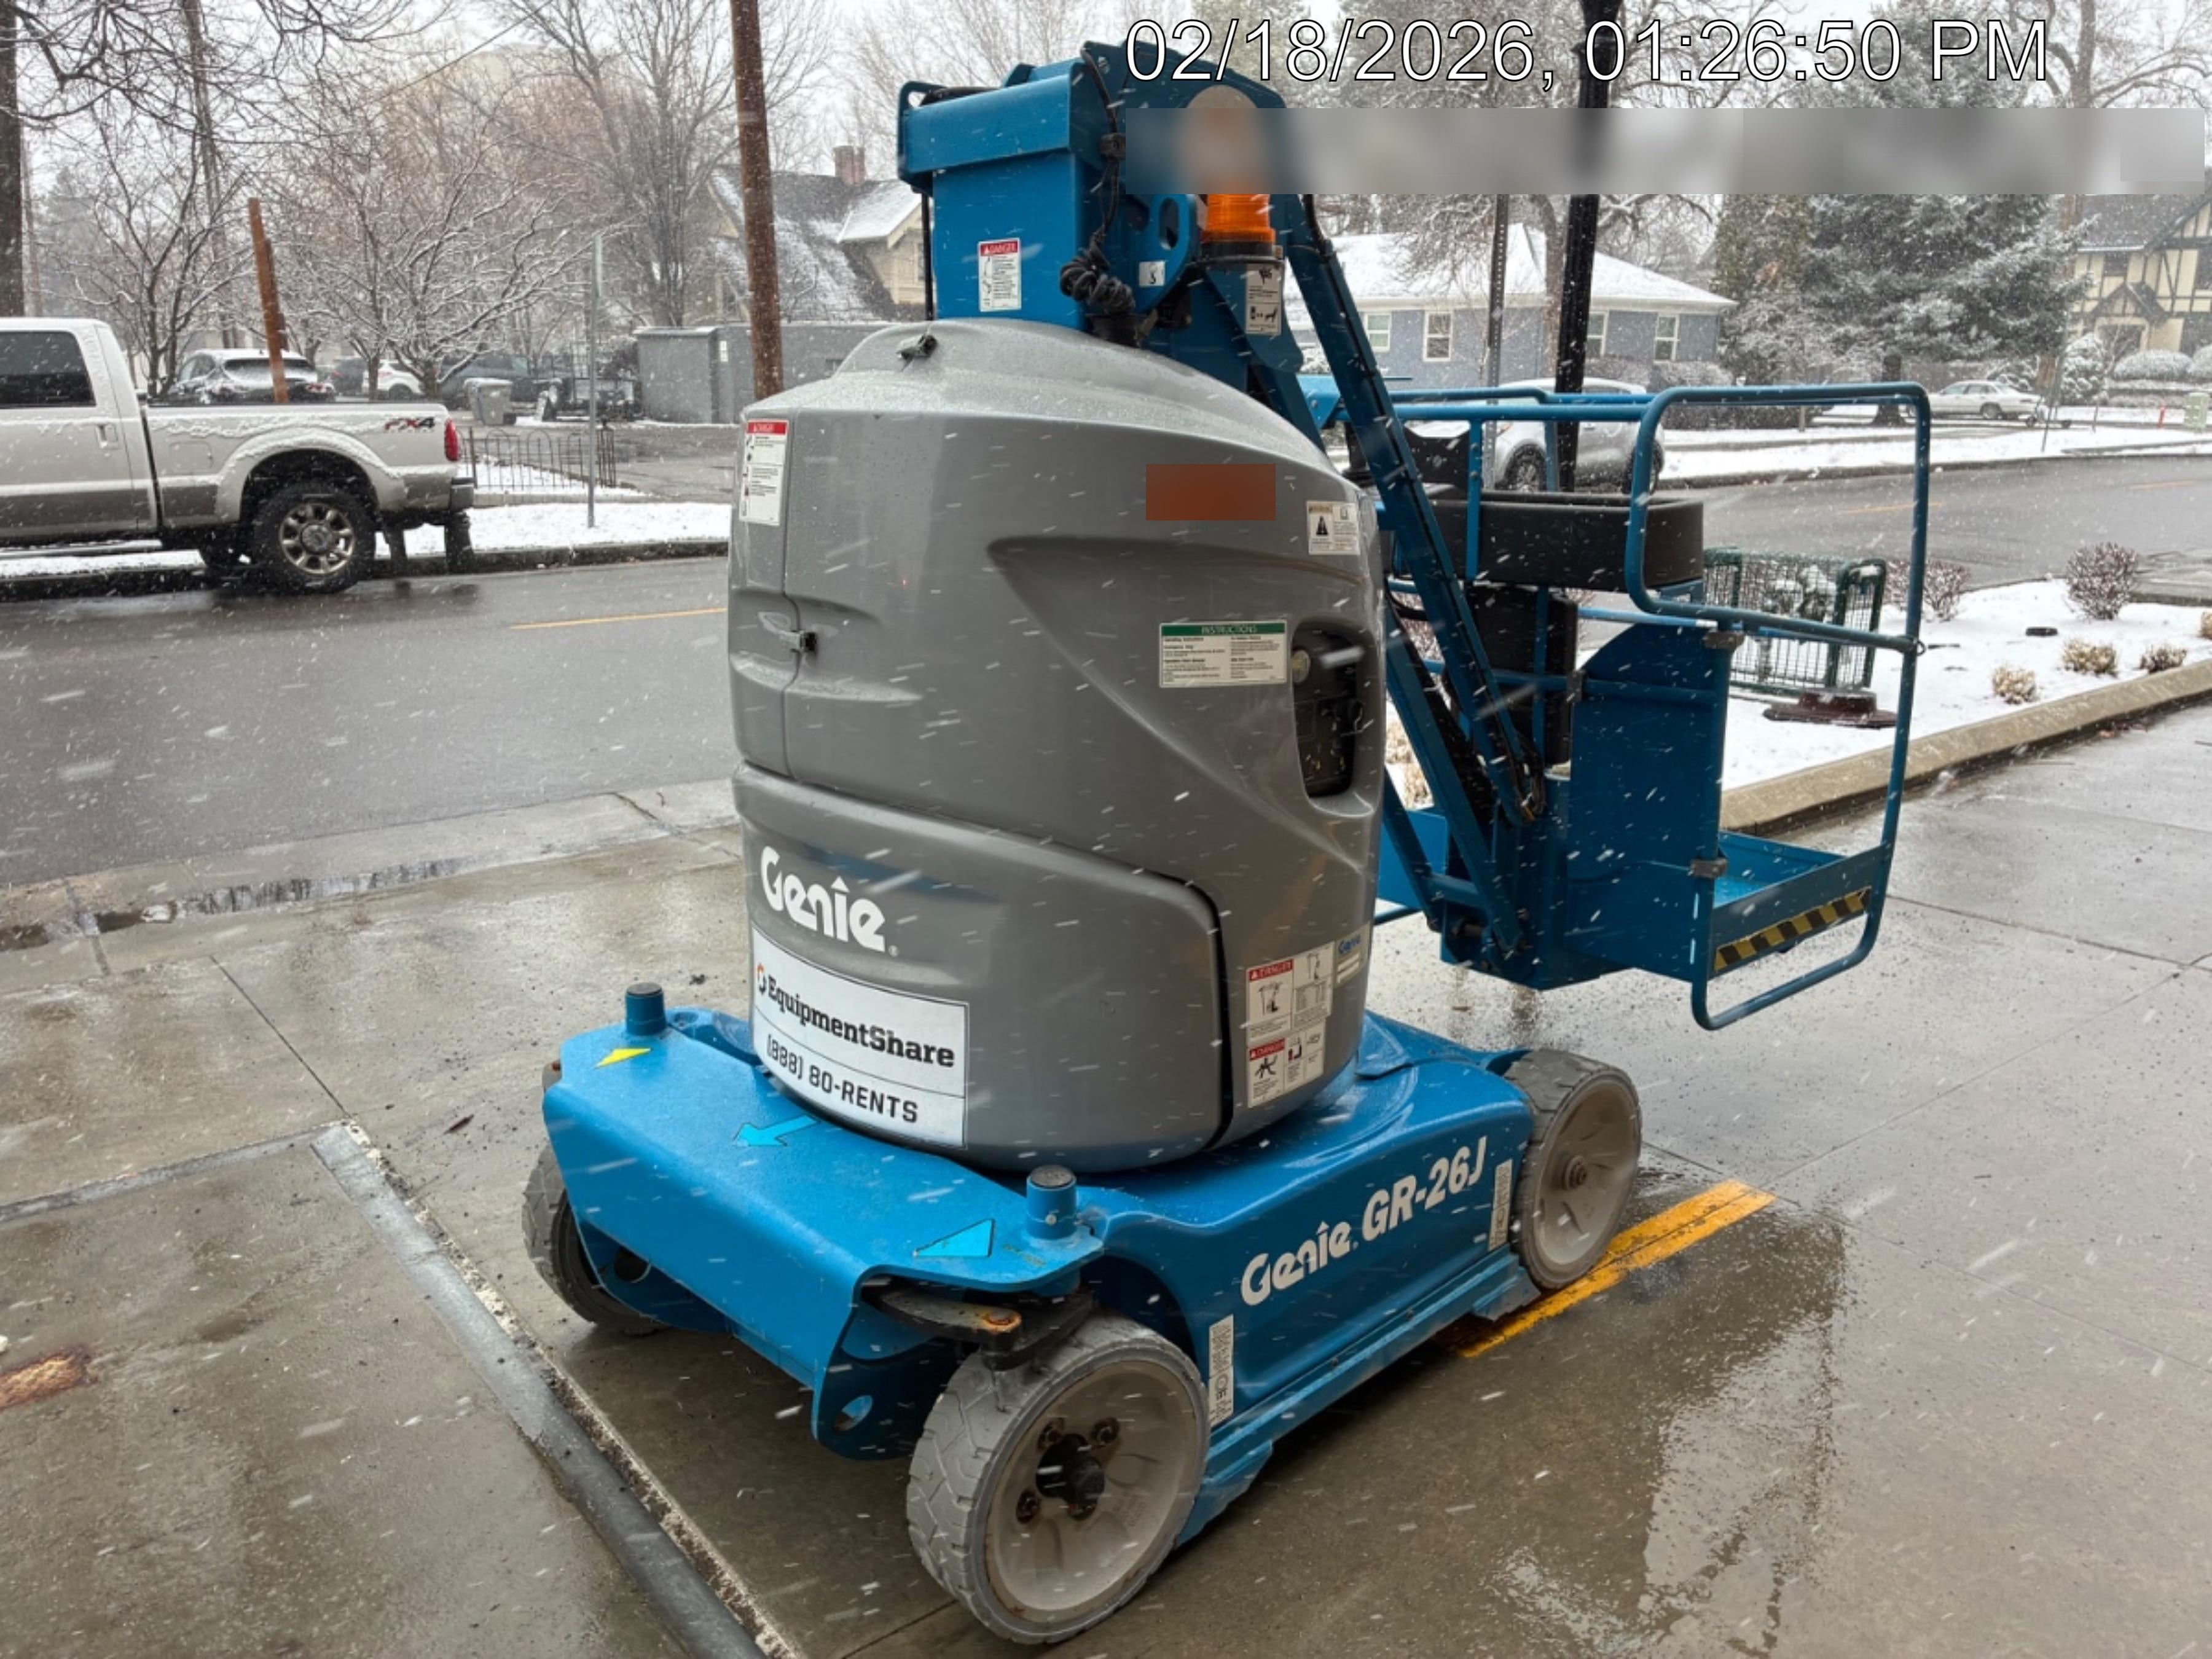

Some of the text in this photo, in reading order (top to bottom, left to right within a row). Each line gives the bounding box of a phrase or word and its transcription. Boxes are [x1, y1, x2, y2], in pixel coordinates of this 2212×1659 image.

[385, 417, 435, 430] FX4
[761, 845, 885, 952] Genie
[767, 975, 954, 1068] EquipmentShare
[767, 1033, 918, 1123] (888) 80-RENTS
[1241, 1220, 1351, 1306] Genie
[1362, 1135, 1487, 1242] GR-26J
